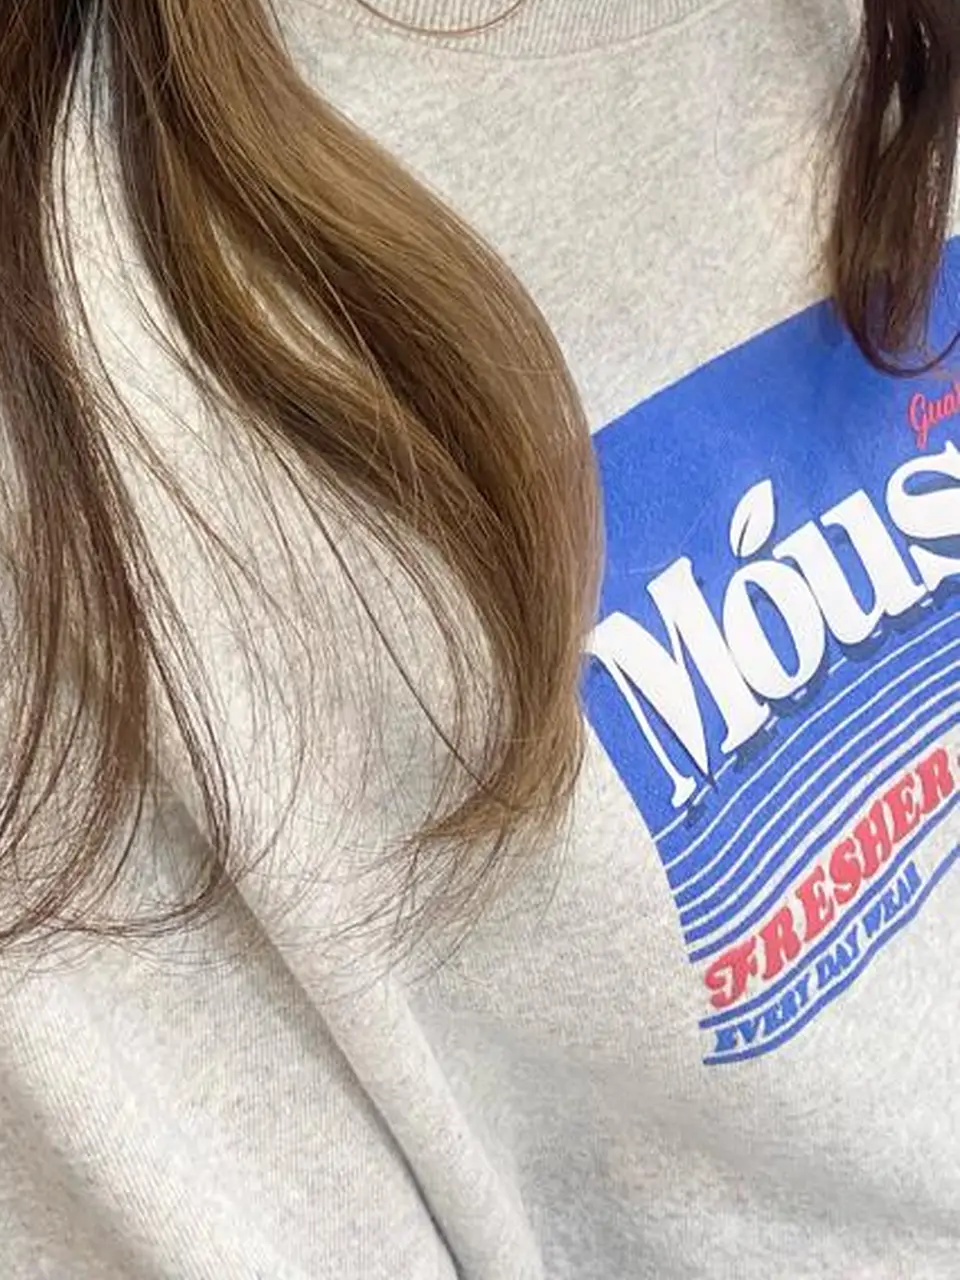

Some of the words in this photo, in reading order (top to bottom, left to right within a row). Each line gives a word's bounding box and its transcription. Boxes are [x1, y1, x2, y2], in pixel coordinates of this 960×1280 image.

[703, 746, 955, 1008] FRESHER
[714, 972, 810, 1052] EVERY
[815, 923, 861, 989] DAY
